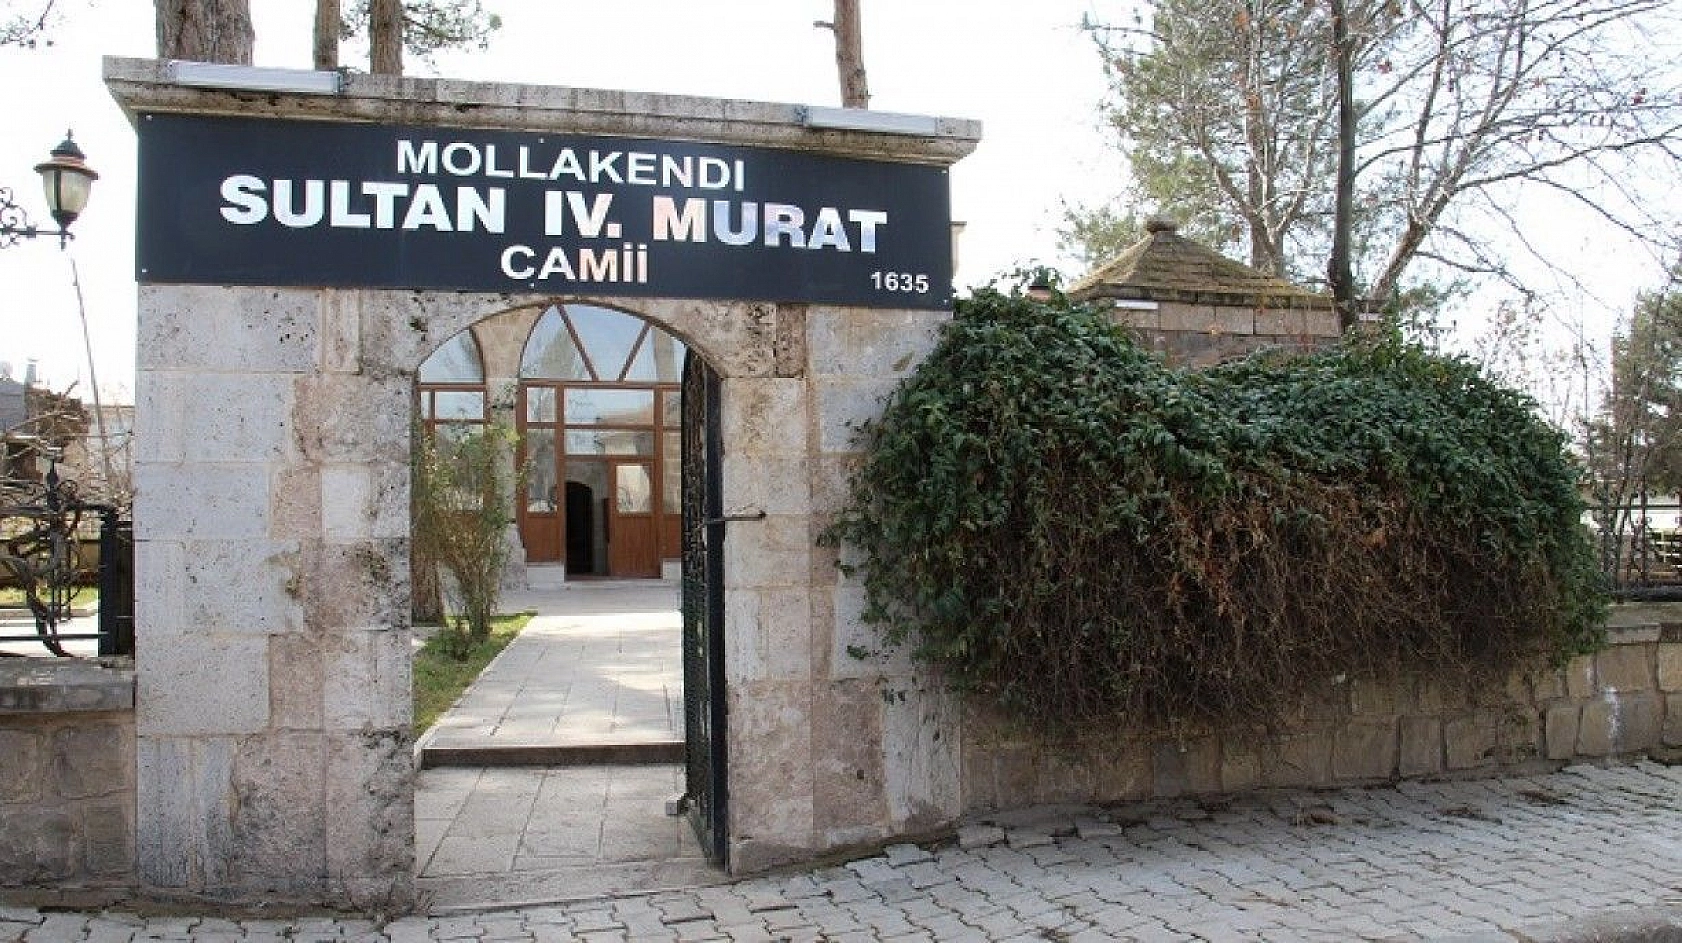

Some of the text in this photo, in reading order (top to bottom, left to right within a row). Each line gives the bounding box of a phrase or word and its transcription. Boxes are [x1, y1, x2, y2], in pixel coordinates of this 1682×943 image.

[397, 139, 745, 192] MOLLAKENDI
[219, 174, 888, 254] SULTAN IV. MURAT
[870, 271, 930, 293] 1635
